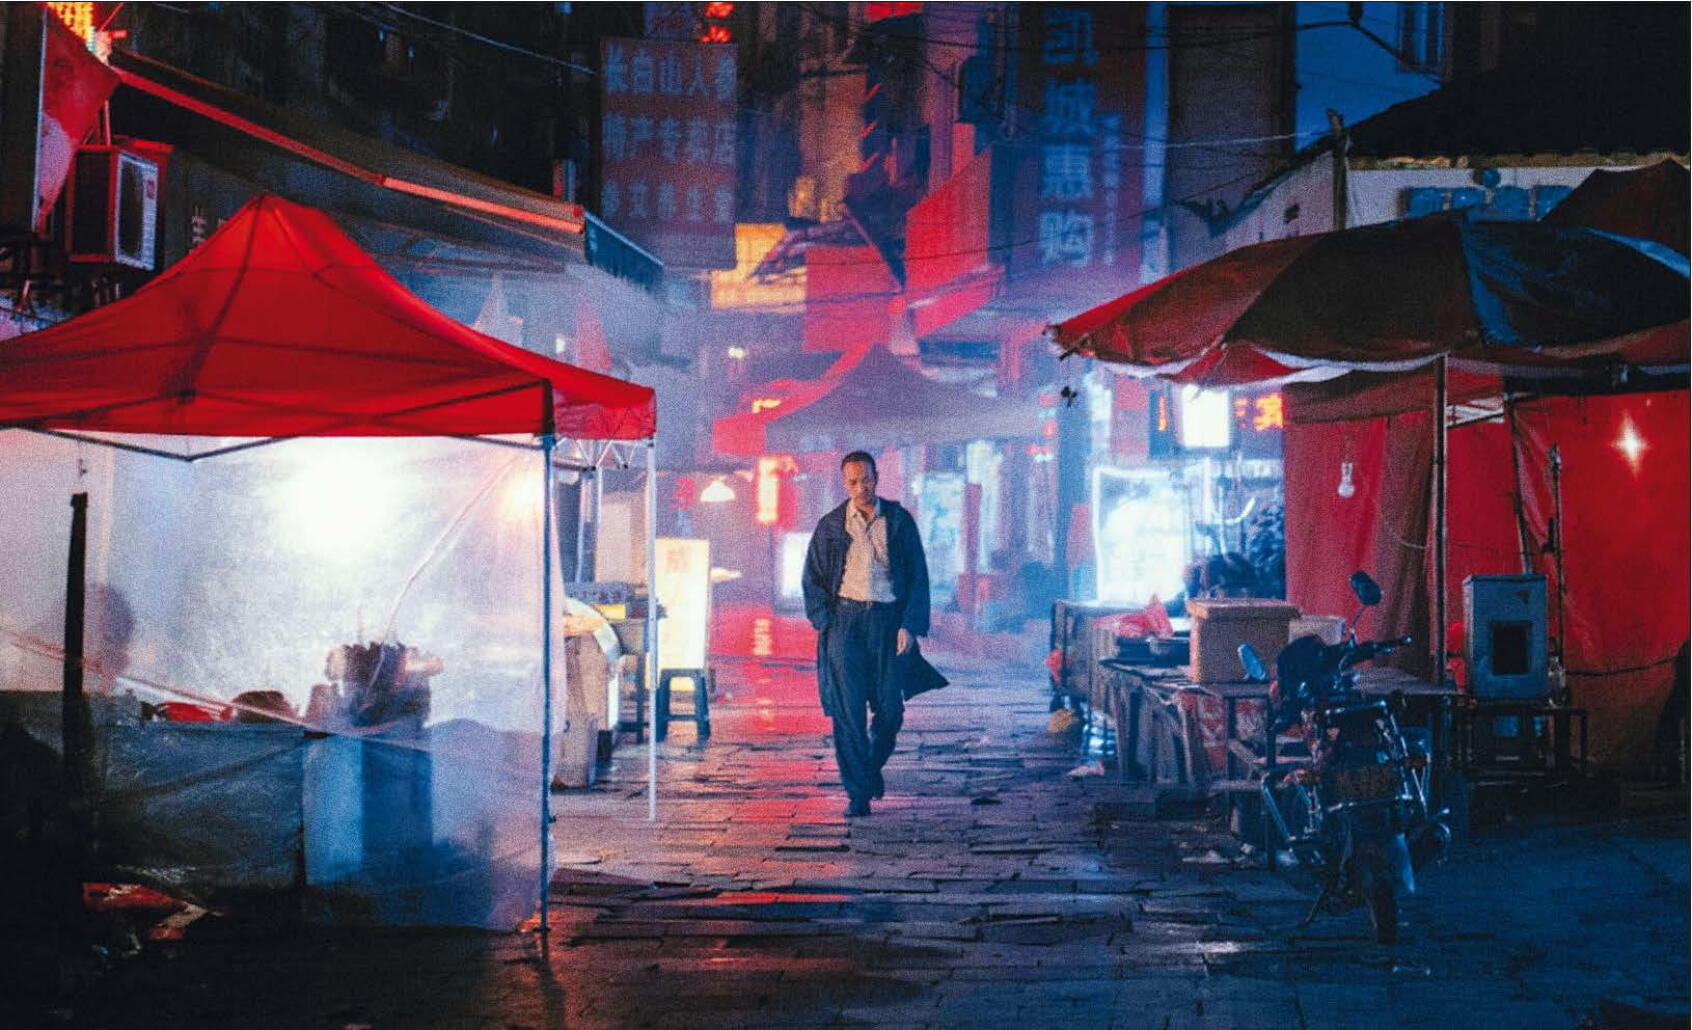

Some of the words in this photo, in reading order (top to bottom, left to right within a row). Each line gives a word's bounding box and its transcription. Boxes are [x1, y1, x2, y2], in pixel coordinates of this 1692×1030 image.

[603, 42, 737, 100] 长白山人参
[1039, 9, 1099, 268] 凯城惠购
